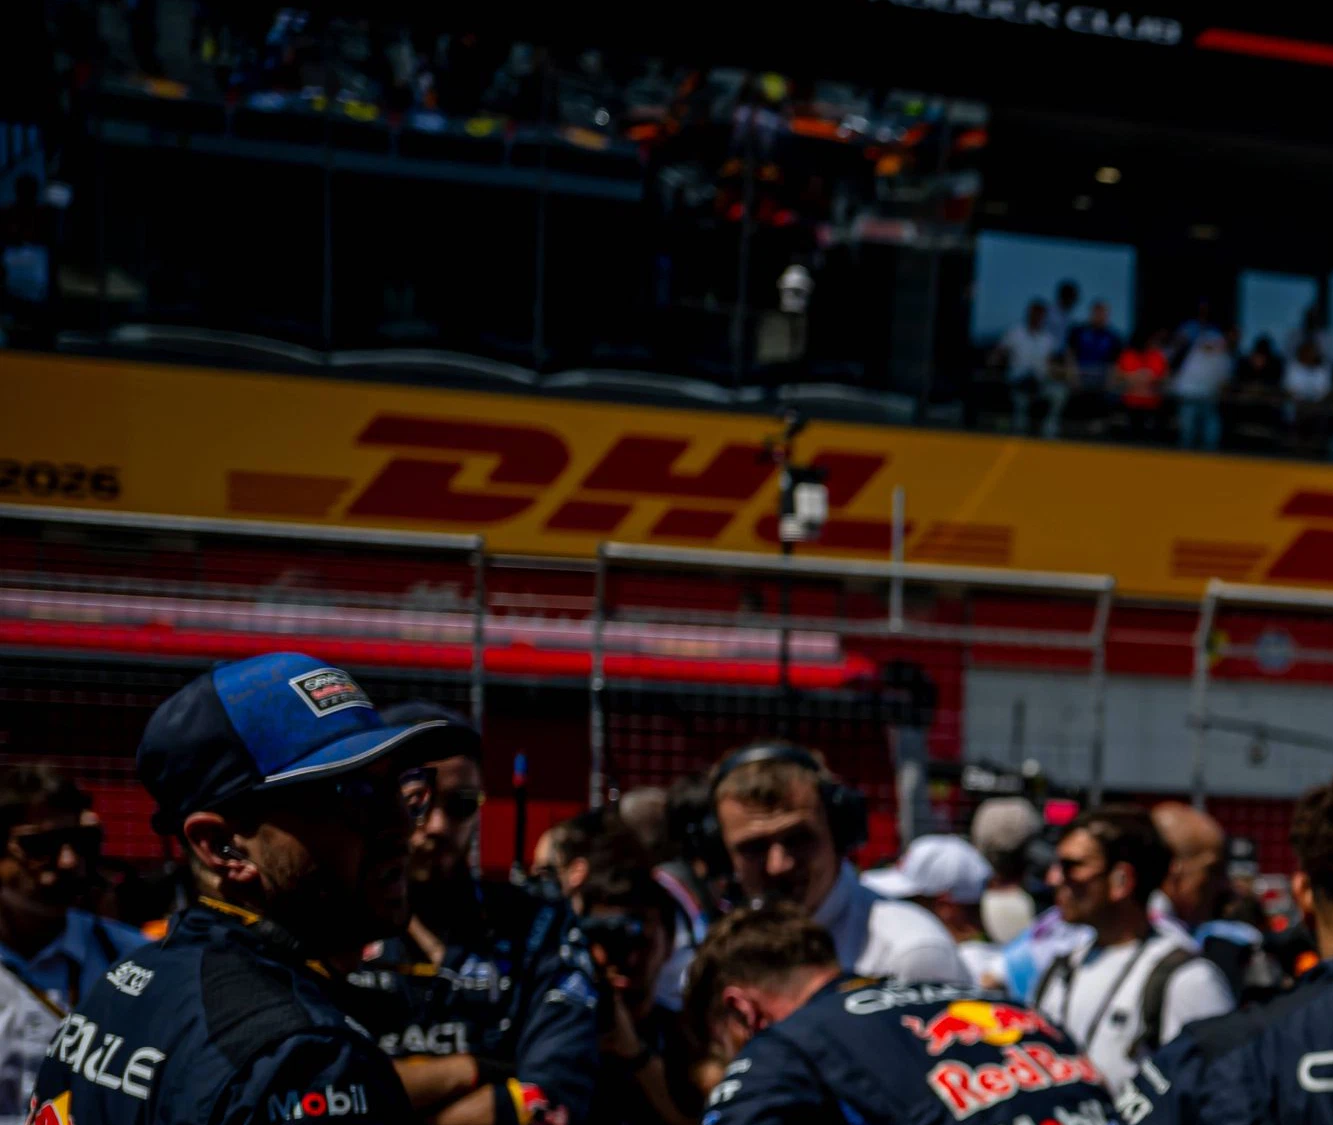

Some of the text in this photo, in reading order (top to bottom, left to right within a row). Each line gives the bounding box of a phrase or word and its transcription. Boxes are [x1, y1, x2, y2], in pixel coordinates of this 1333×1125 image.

[348, 413, 911, 553] DHL
[52, 1012, 168, 1102] RACLE
[266, 1083, 370, 1124] Mobil
